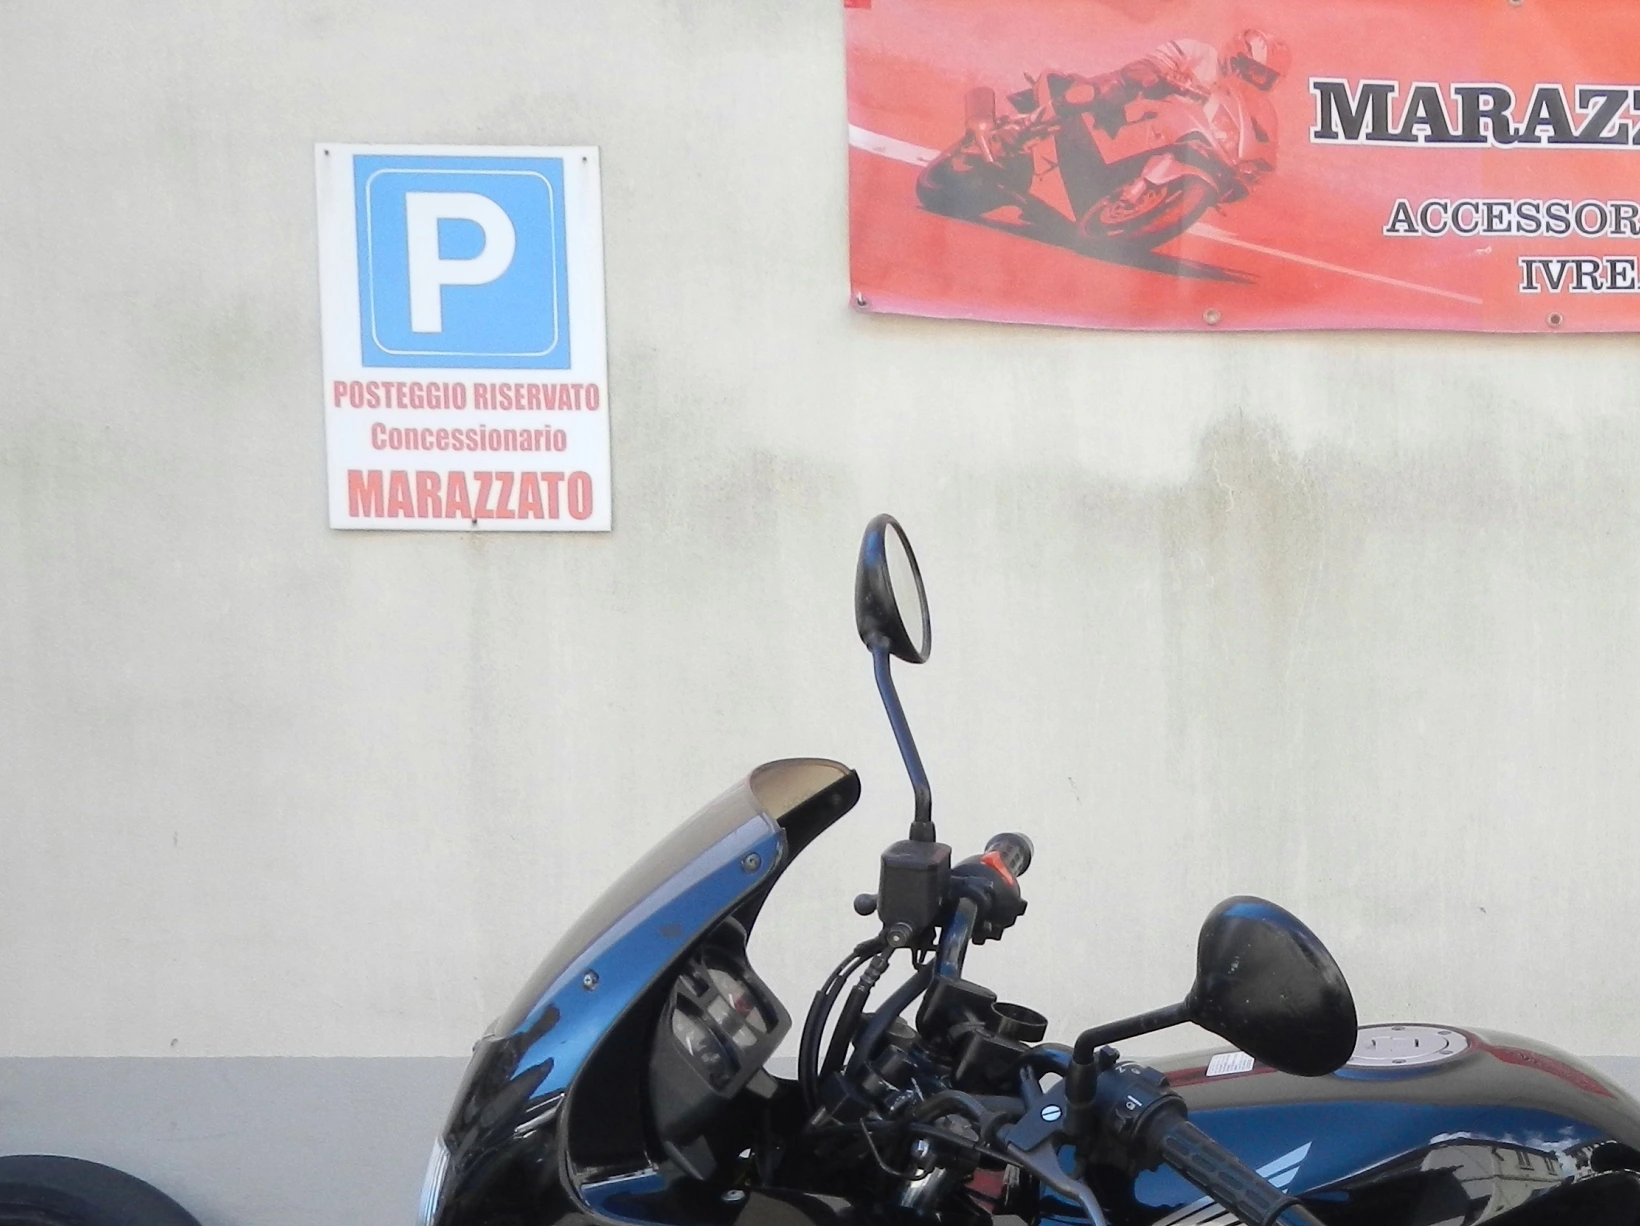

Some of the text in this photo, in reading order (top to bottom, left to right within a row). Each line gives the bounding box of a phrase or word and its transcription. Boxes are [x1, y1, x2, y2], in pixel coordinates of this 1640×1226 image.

[405, 192, 516, 333] P
[333, 381, 600, 411] POSTEGGIO RISERVATO
[371, 422, 567, 452] Concessionario
[347, 469, 594, 521] MARAZZATO
